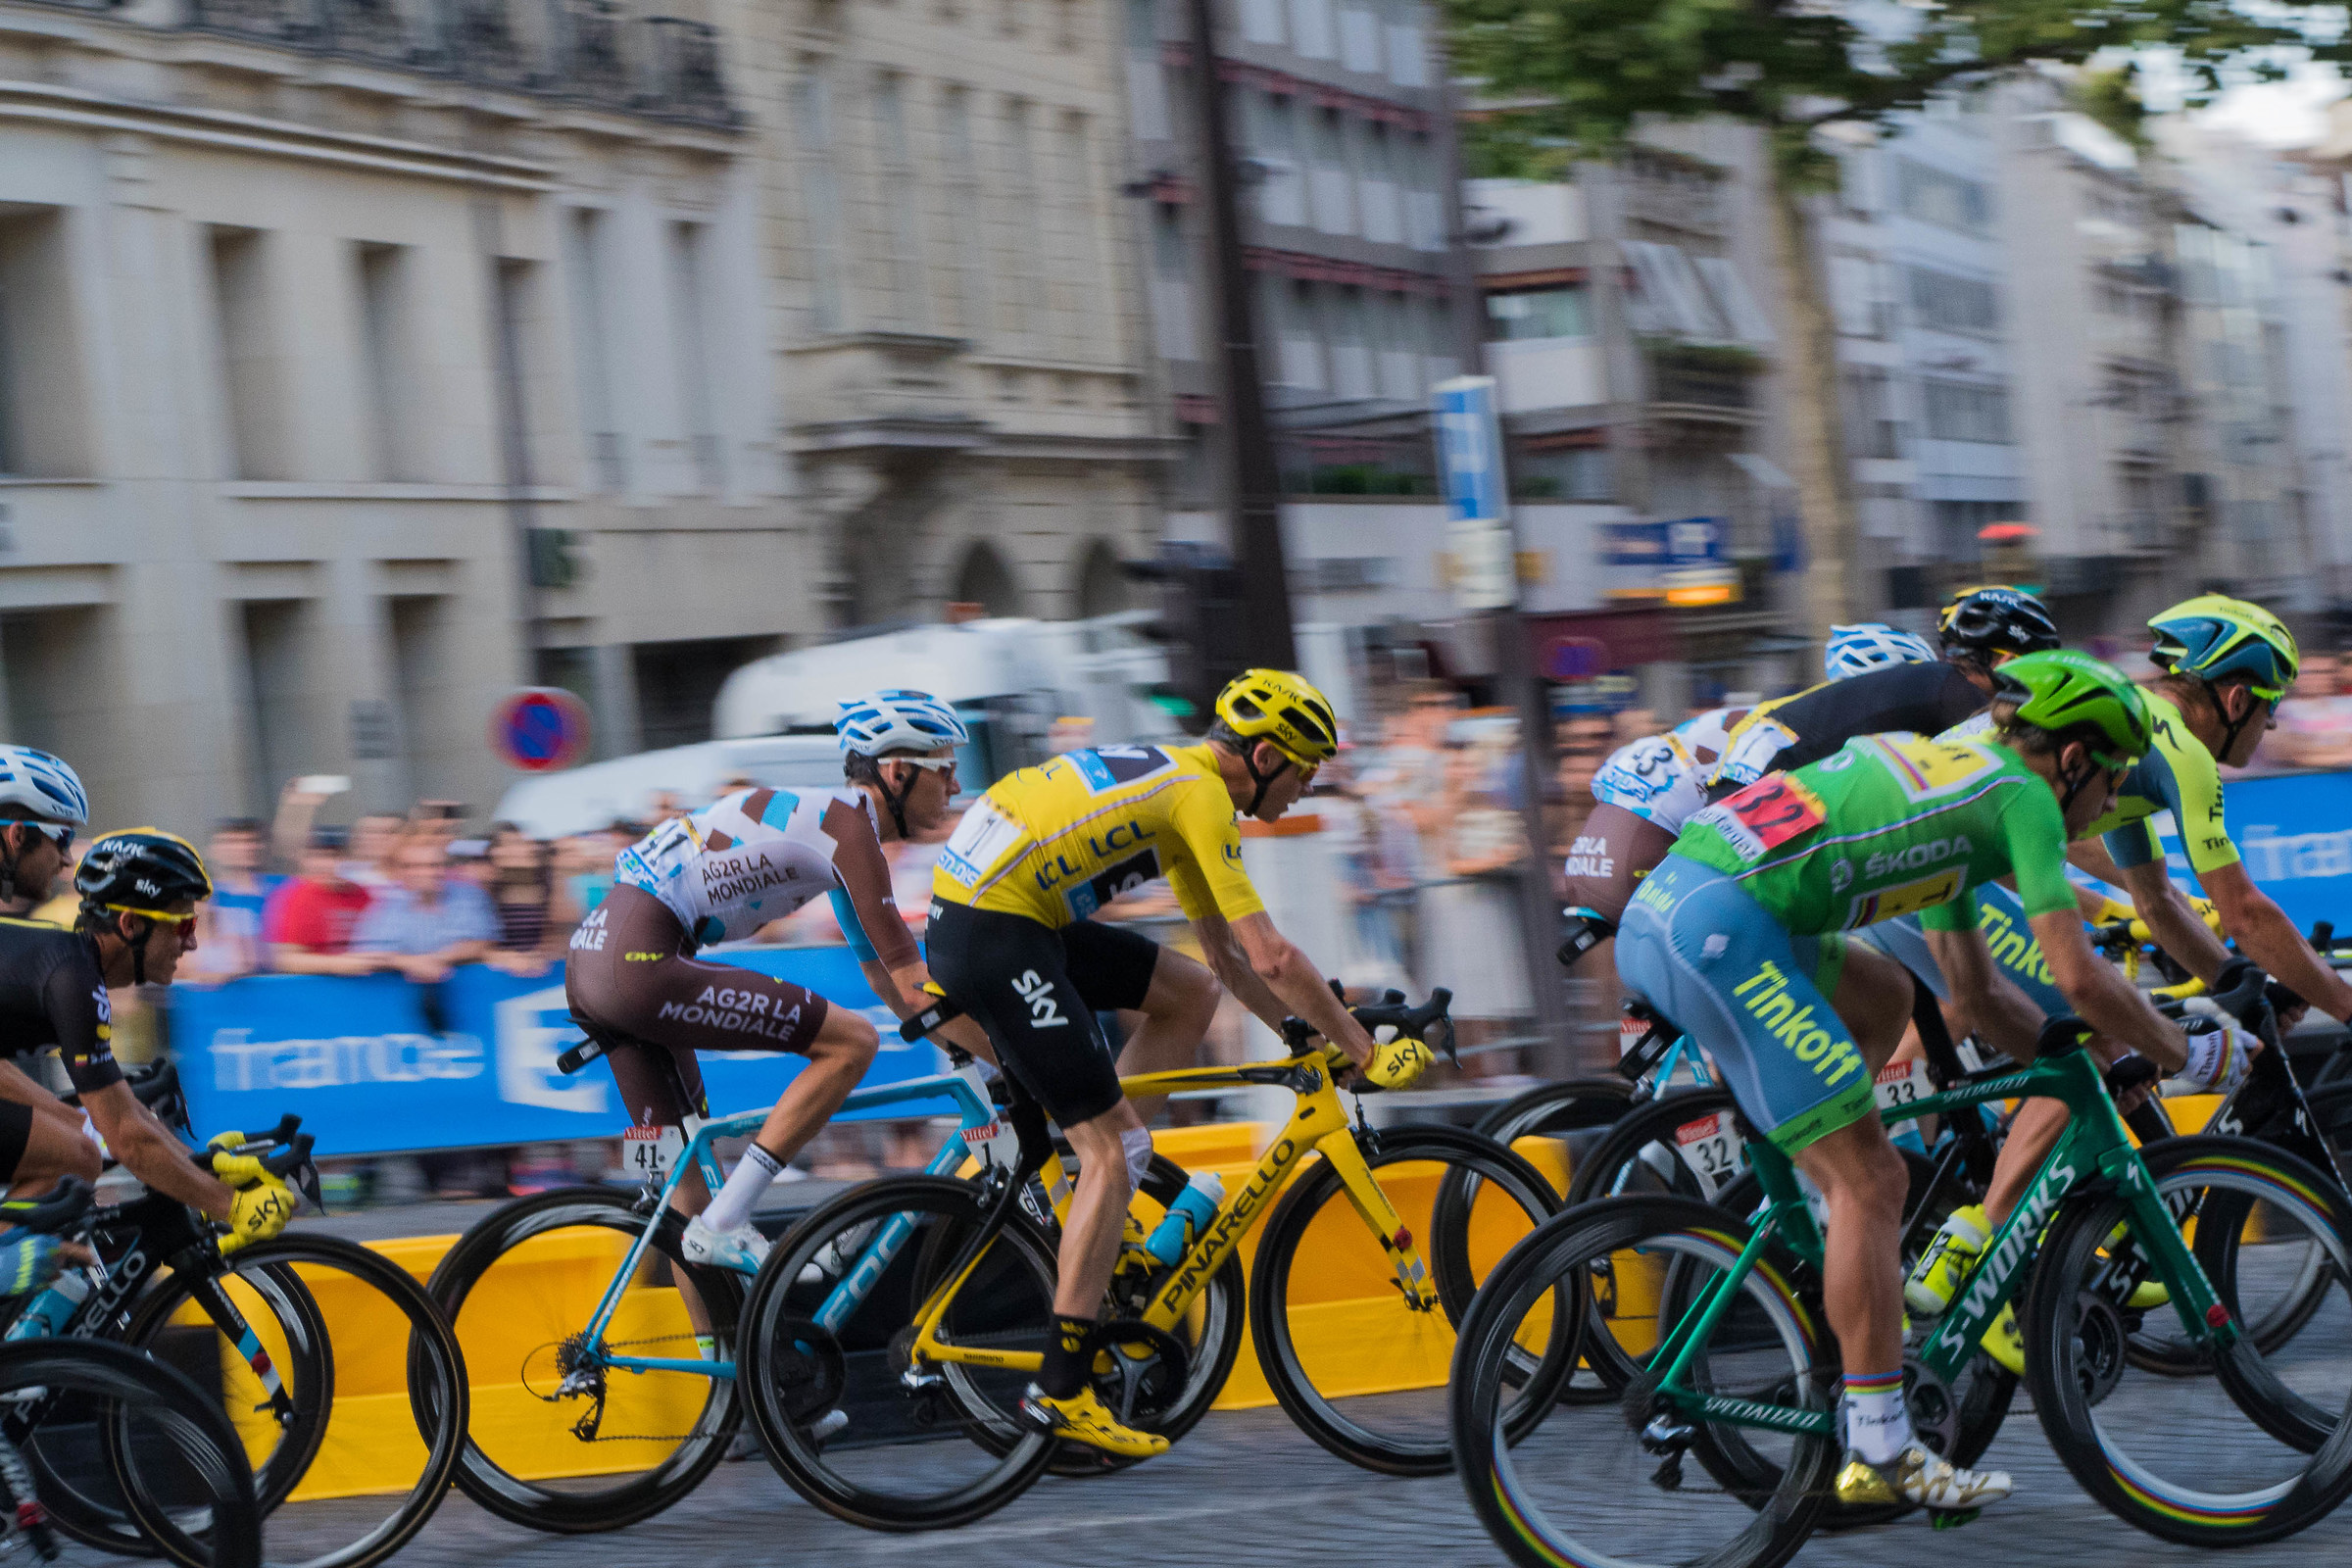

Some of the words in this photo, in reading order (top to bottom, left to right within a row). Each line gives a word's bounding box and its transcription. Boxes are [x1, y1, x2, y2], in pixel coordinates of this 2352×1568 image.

[1732, 785, 1804, 837] 32
[964, 816, 997, 857] 1
[1089, 820, 1155, 858] LCL
[702, 859, 742, 886] AG2R
[747, 852, 774, 873] LA
[1865, 836, 1974, 880] ŠKODA
[707, 866, 800, 906] MONDIALE
[1980, 903, 2055, 985] Tink
[696, 985, 770, 1016] AG2R
[772, 998, 802, 1025] LA
[1011, 968, 1069, 1028] sky
[658, 1001, 797, 1043] MONDIALE
[1733, 959, 1862, 1087] Tinkoff
[1387, 1041, 1421, 1077] sky
[1886, 1082, 1917, 1106] 33
[625, 1127, 660, 1140] Vittel
[635, 1143, 659, 1169] 41
[982, 1142, 993, 1167] 1
[1696, 1137, 1734, 1174] 32
[248, 1190, 281, 1232] sky
[1163, 1139, 1295, 1313] PINARELLO
[1939, 1153, 2077, 1365] S-WORKS
[73, 1250, 147, 1339] RELLO
